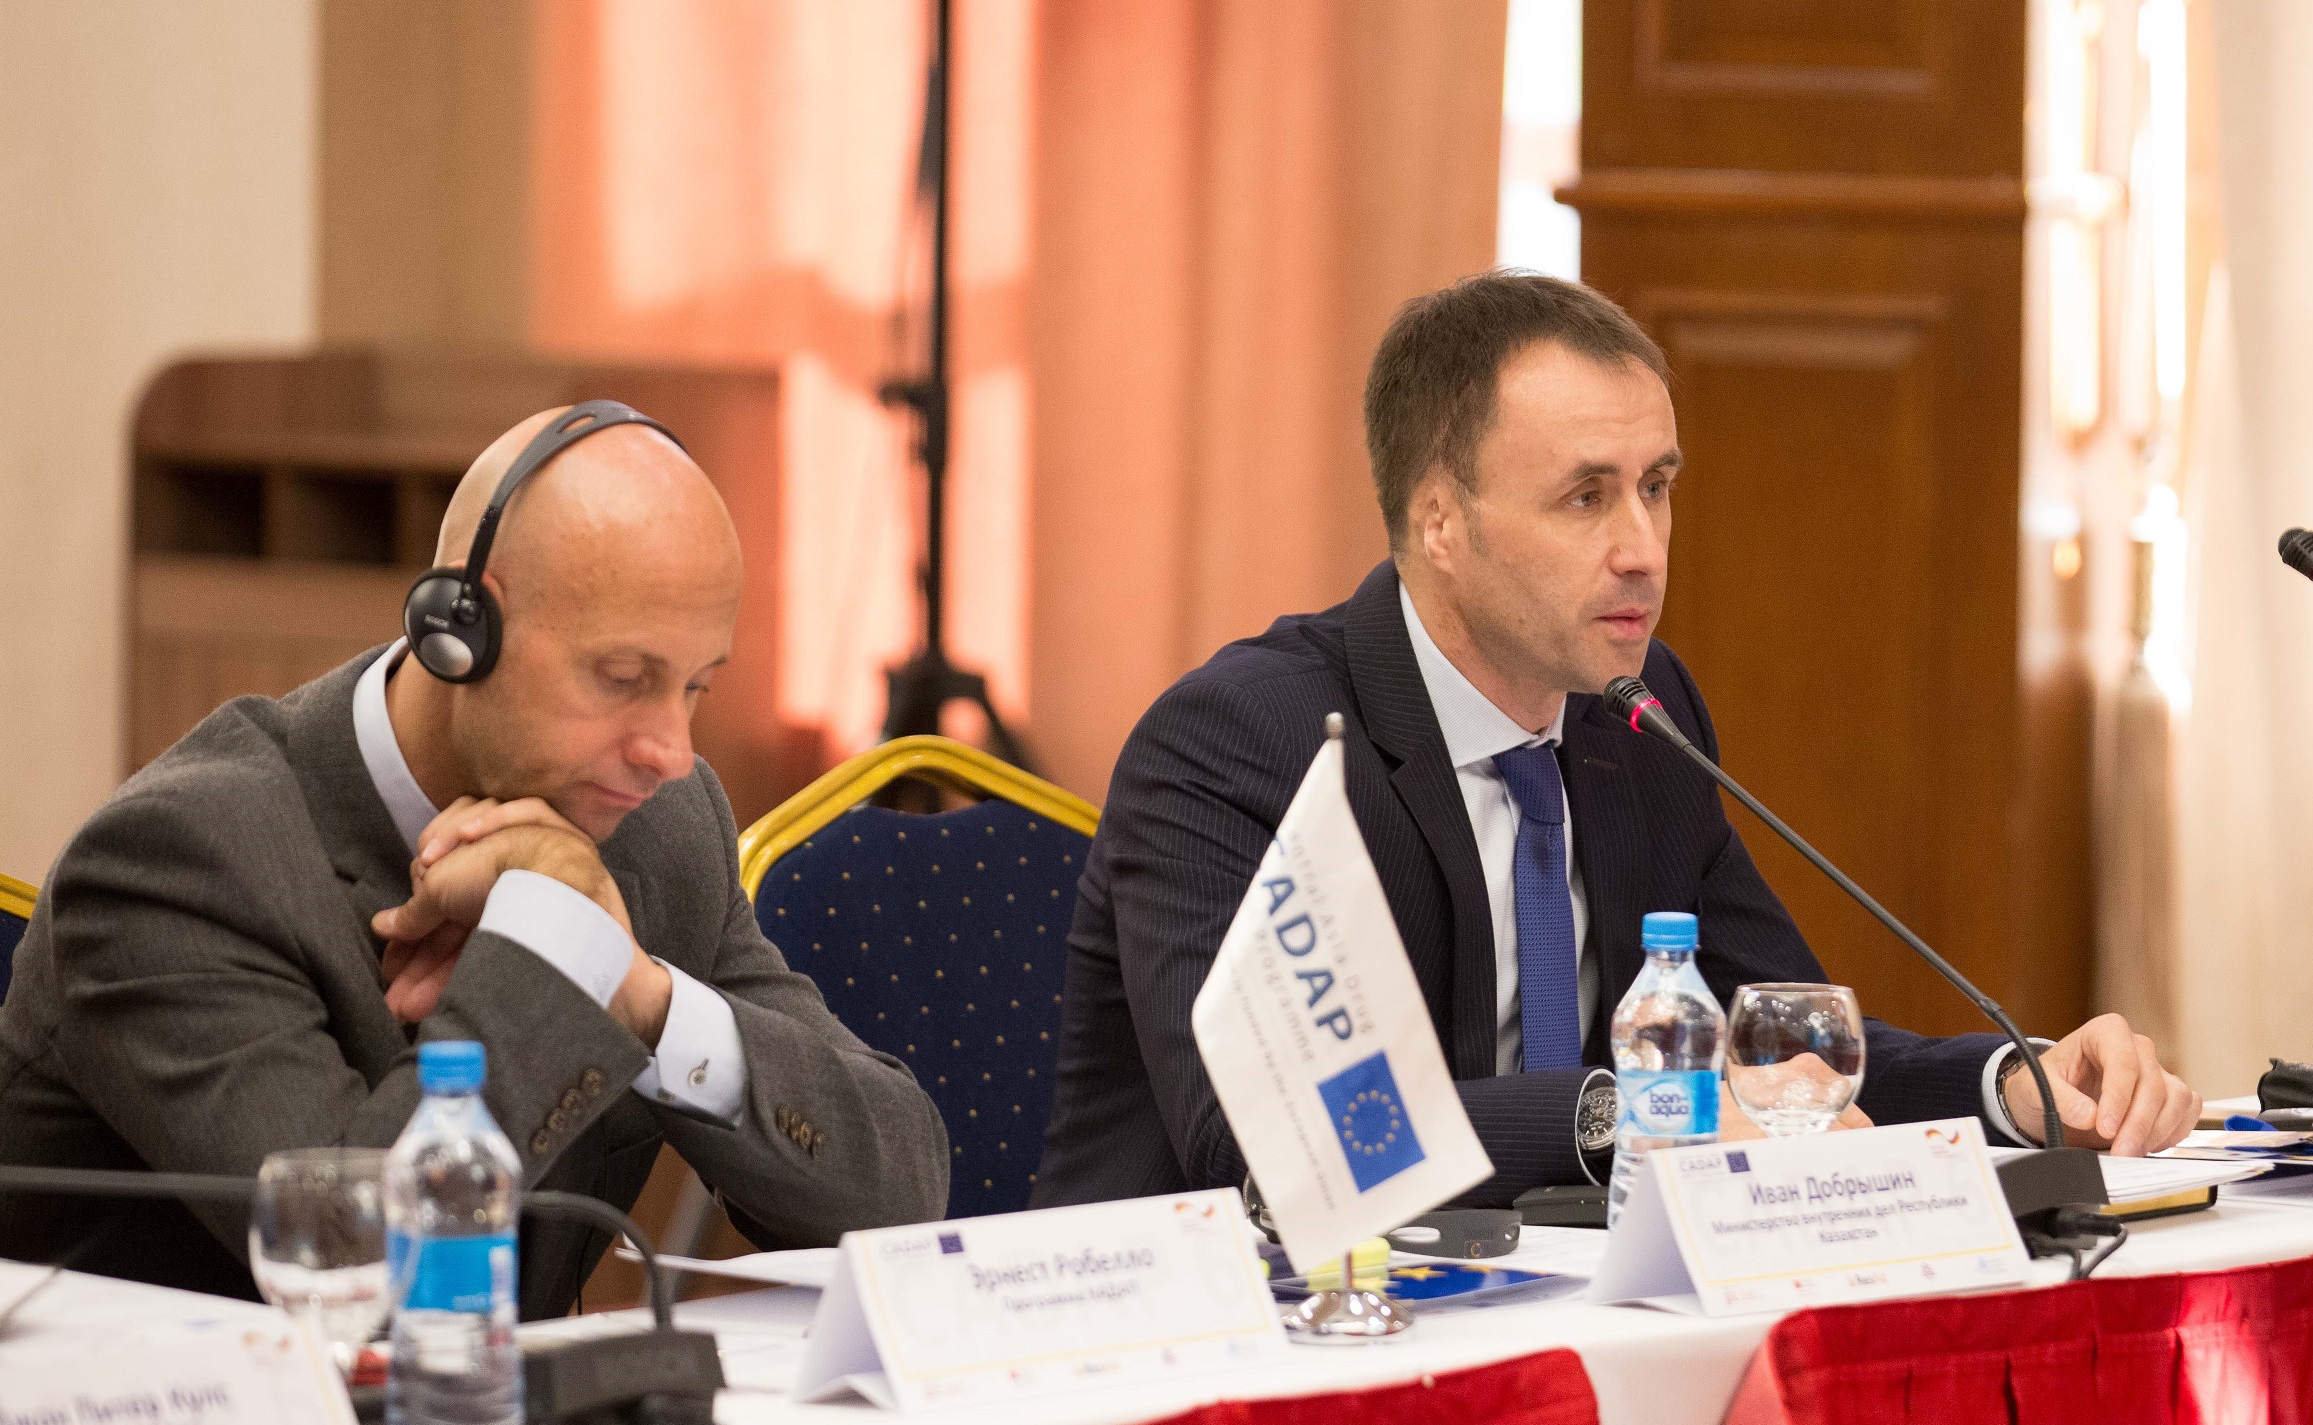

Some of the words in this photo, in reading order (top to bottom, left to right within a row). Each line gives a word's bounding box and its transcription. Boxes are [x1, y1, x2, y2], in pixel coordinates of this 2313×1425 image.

[1290, 830, 1329, 907] entral
[1319, 914, 1347, 965] Asia
[1344, 973, 1375, 1036] Drug
[1255, 927, 1315, 1062] Programme
[1650, 1105, 1688, 1117] aqua
[1748, 1181, 1800, 1205] Иван
[1806, 1170, 1916, 1205] Добрышин
[1711, 1213, 1799, 1235] Министерство
[1875, 1202, 1896, 1218] дел
[1897, 1194, 1969, 1215] Республики
